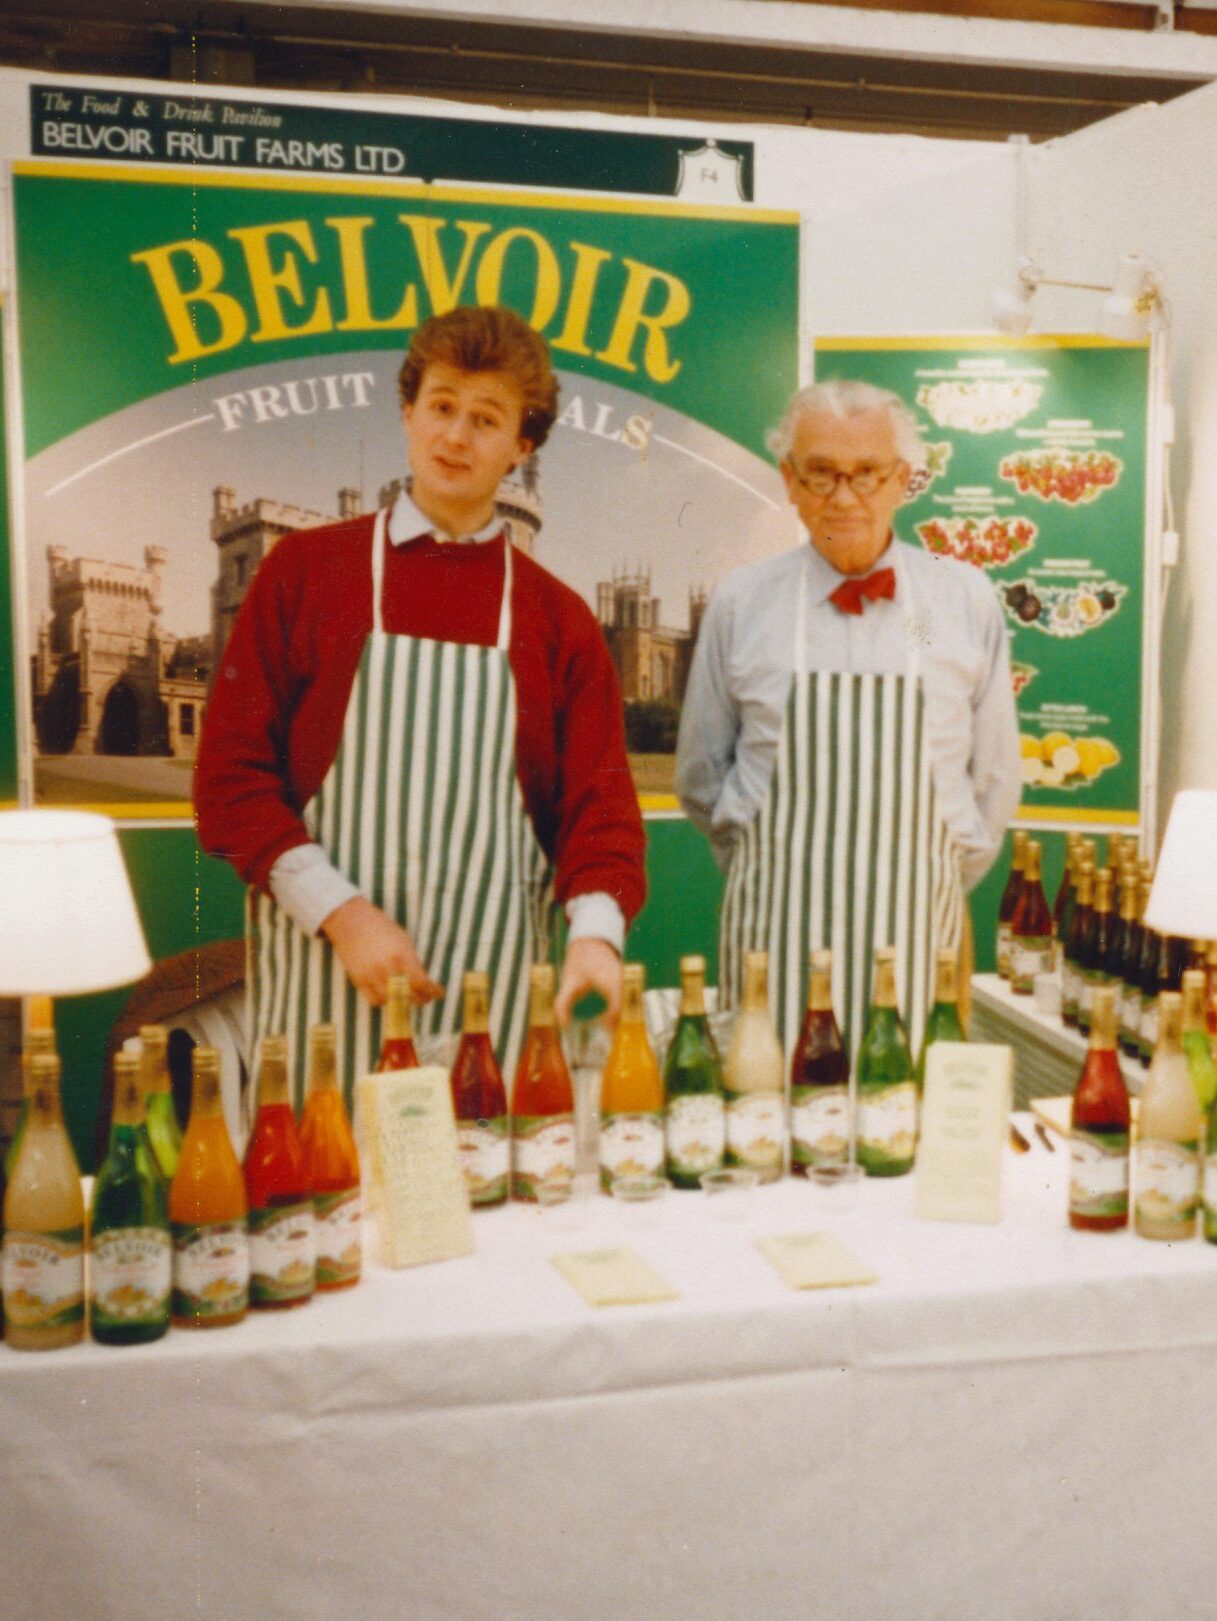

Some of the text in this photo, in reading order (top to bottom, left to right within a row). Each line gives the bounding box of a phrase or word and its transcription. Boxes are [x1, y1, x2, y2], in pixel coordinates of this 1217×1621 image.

[41, 92, 284, 129] The Food & Drink Pavilion
[42, 121, 406, 173] BELVOIR FRUIT FARMS LTD
[130, 213, 692, 384] BELVOIR
[211, 371, 376, 432] FRUIT
